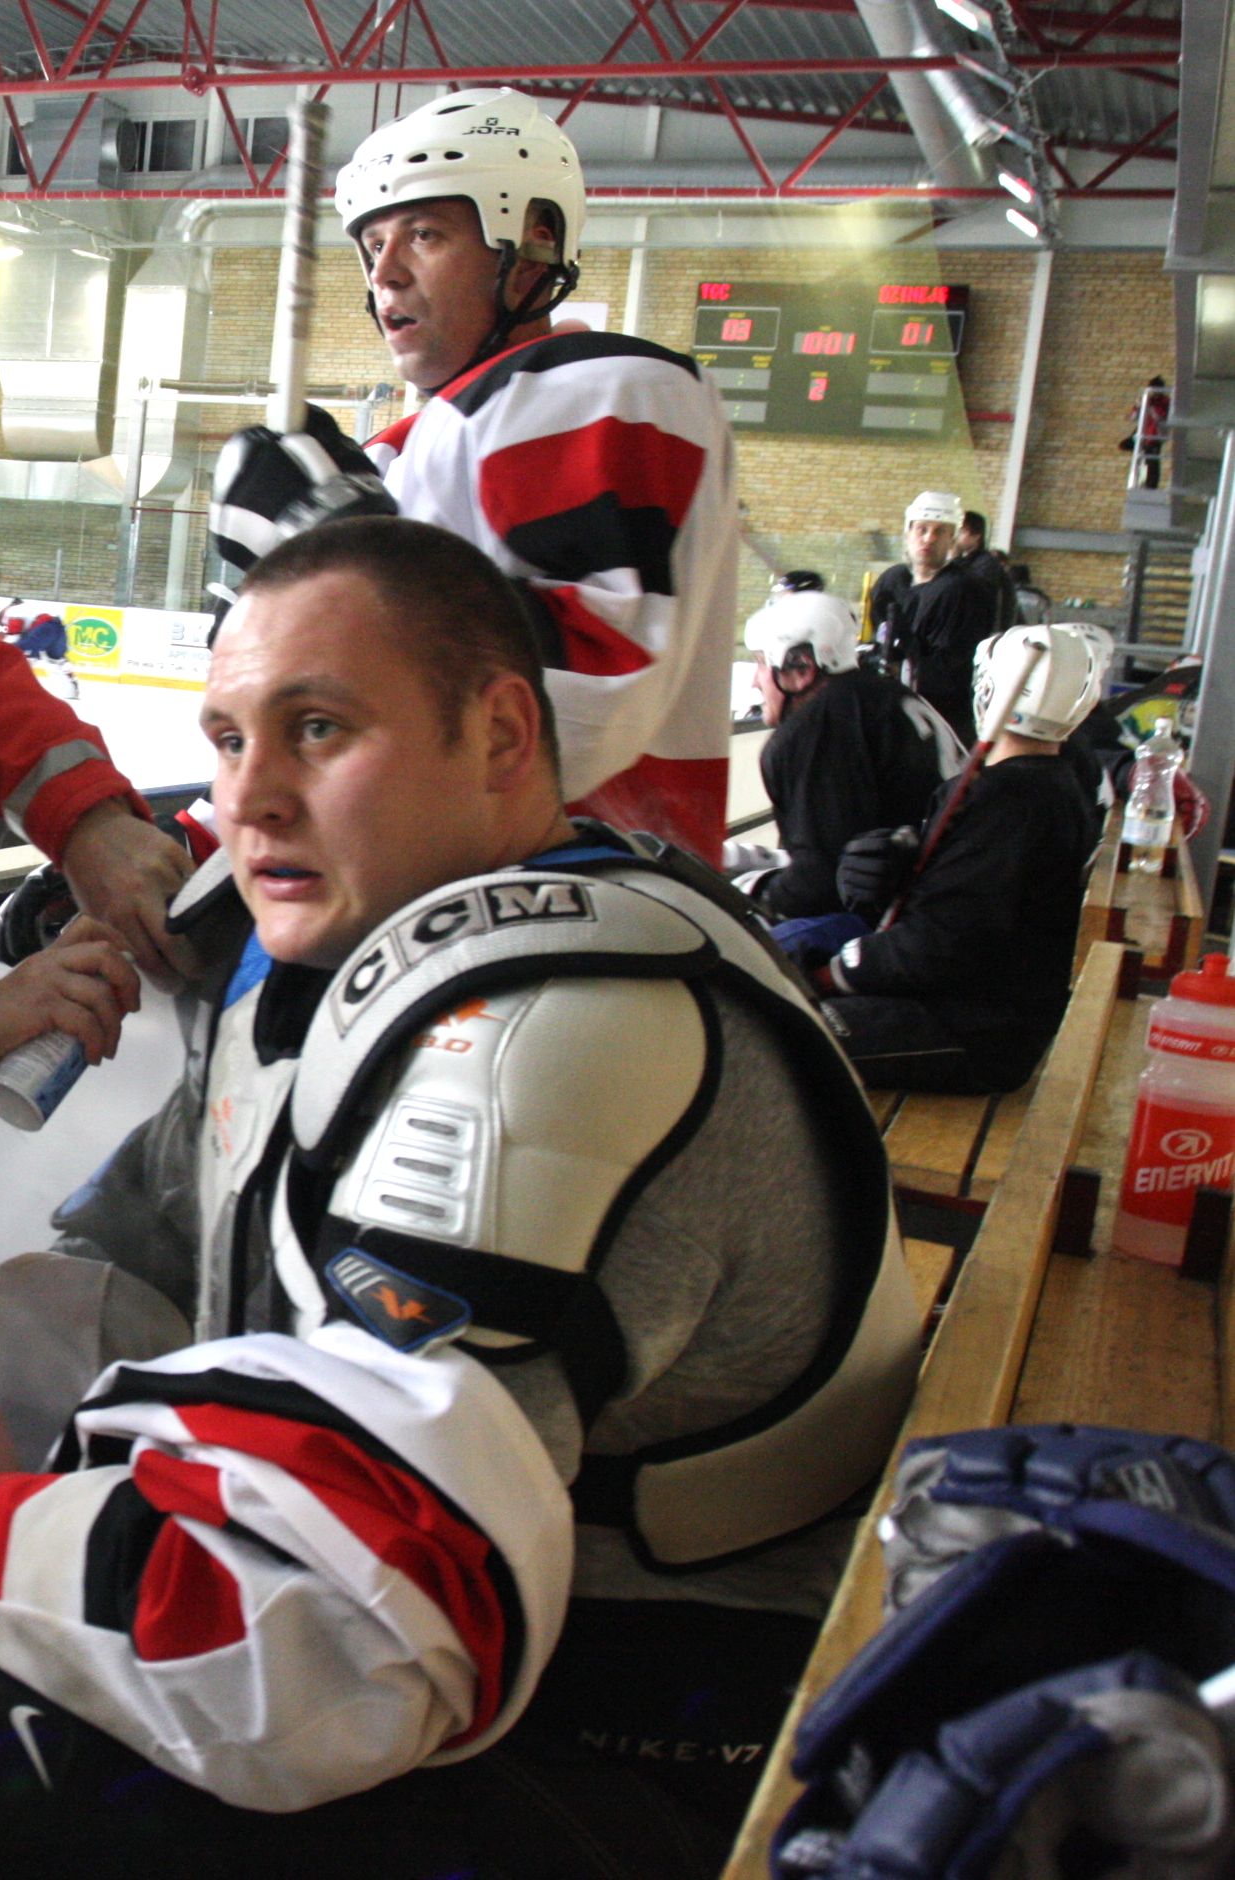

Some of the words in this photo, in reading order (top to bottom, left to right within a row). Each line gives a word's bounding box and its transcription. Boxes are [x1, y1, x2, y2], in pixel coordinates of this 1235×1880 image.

[462, 126, 521, 136] JOFA
[808, 377, 829, 401] 2
[343, 883, 588, 1005] CCM
[581, 1730, 700, 1761] NIKE
